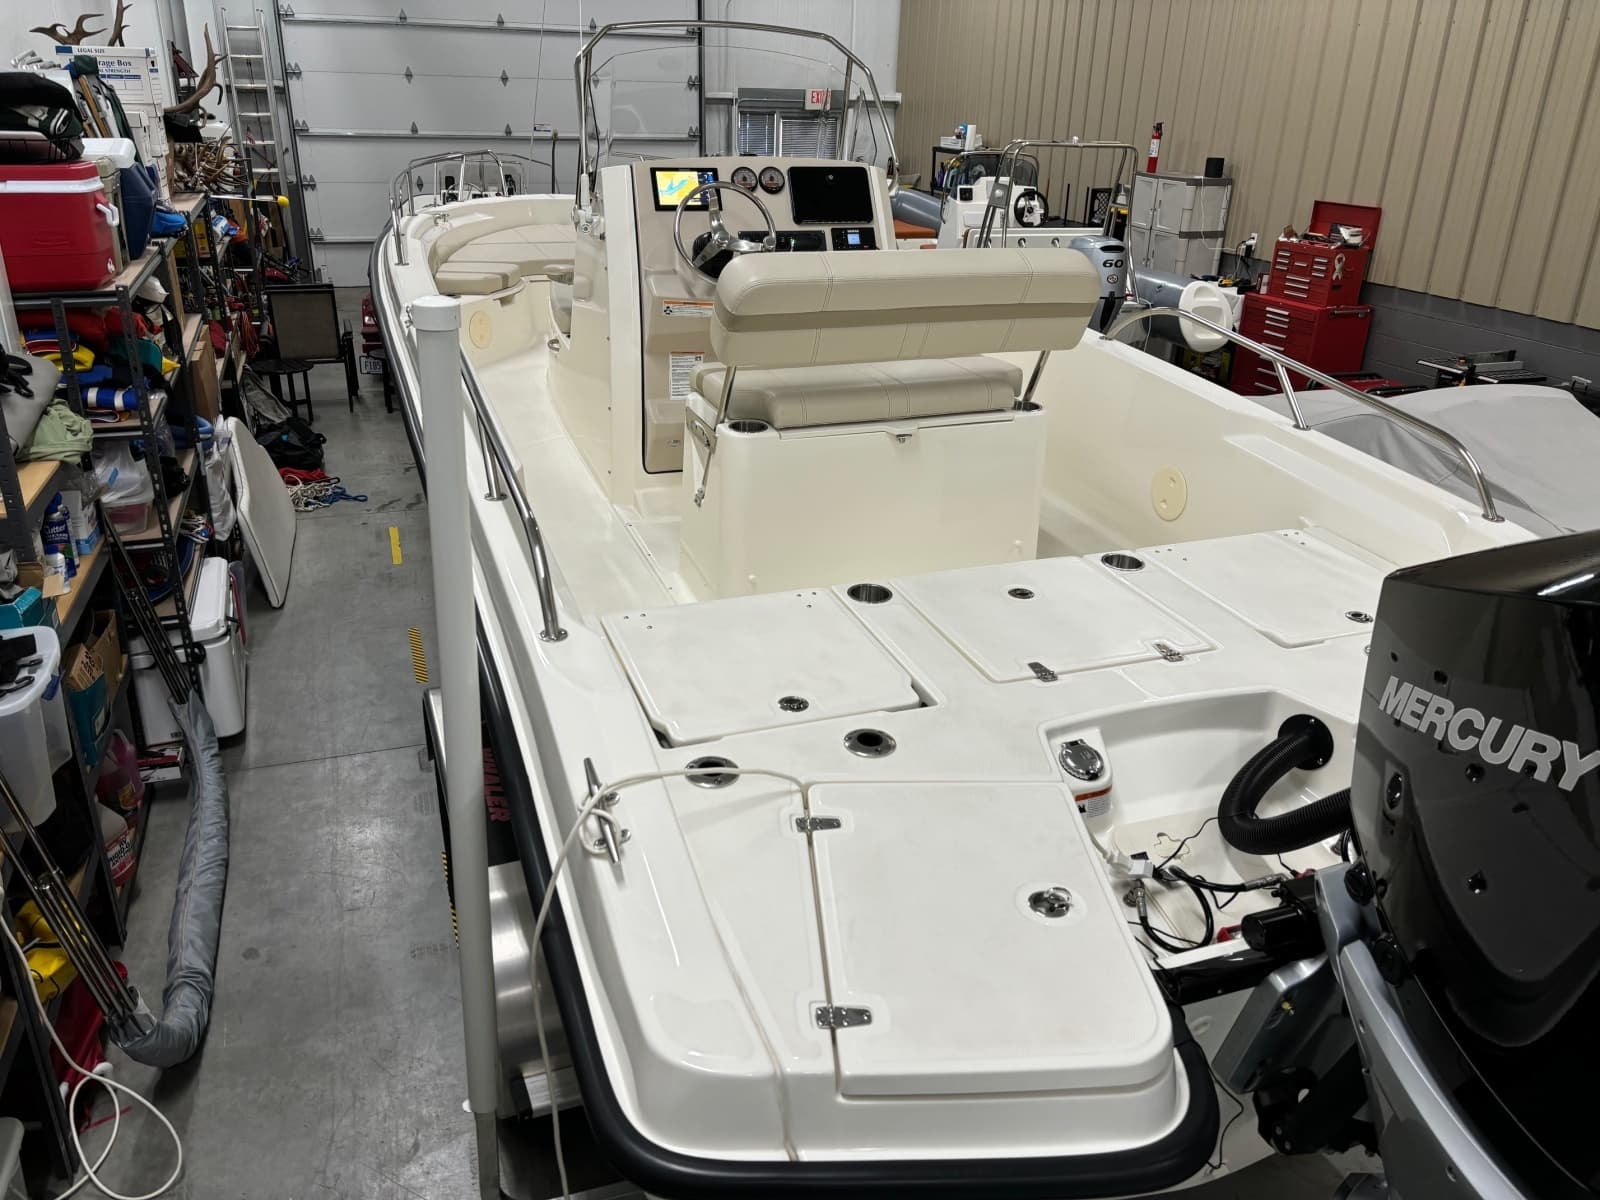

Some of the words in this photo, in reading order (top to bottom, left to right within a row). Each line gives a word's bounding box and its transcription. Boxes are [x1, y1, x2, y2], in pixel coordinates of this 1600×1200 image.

[98, 60, 115, 68] rage
[1102, 259, 1124, 268] 60
[1378, 675, 1600, 792] MERCURY
